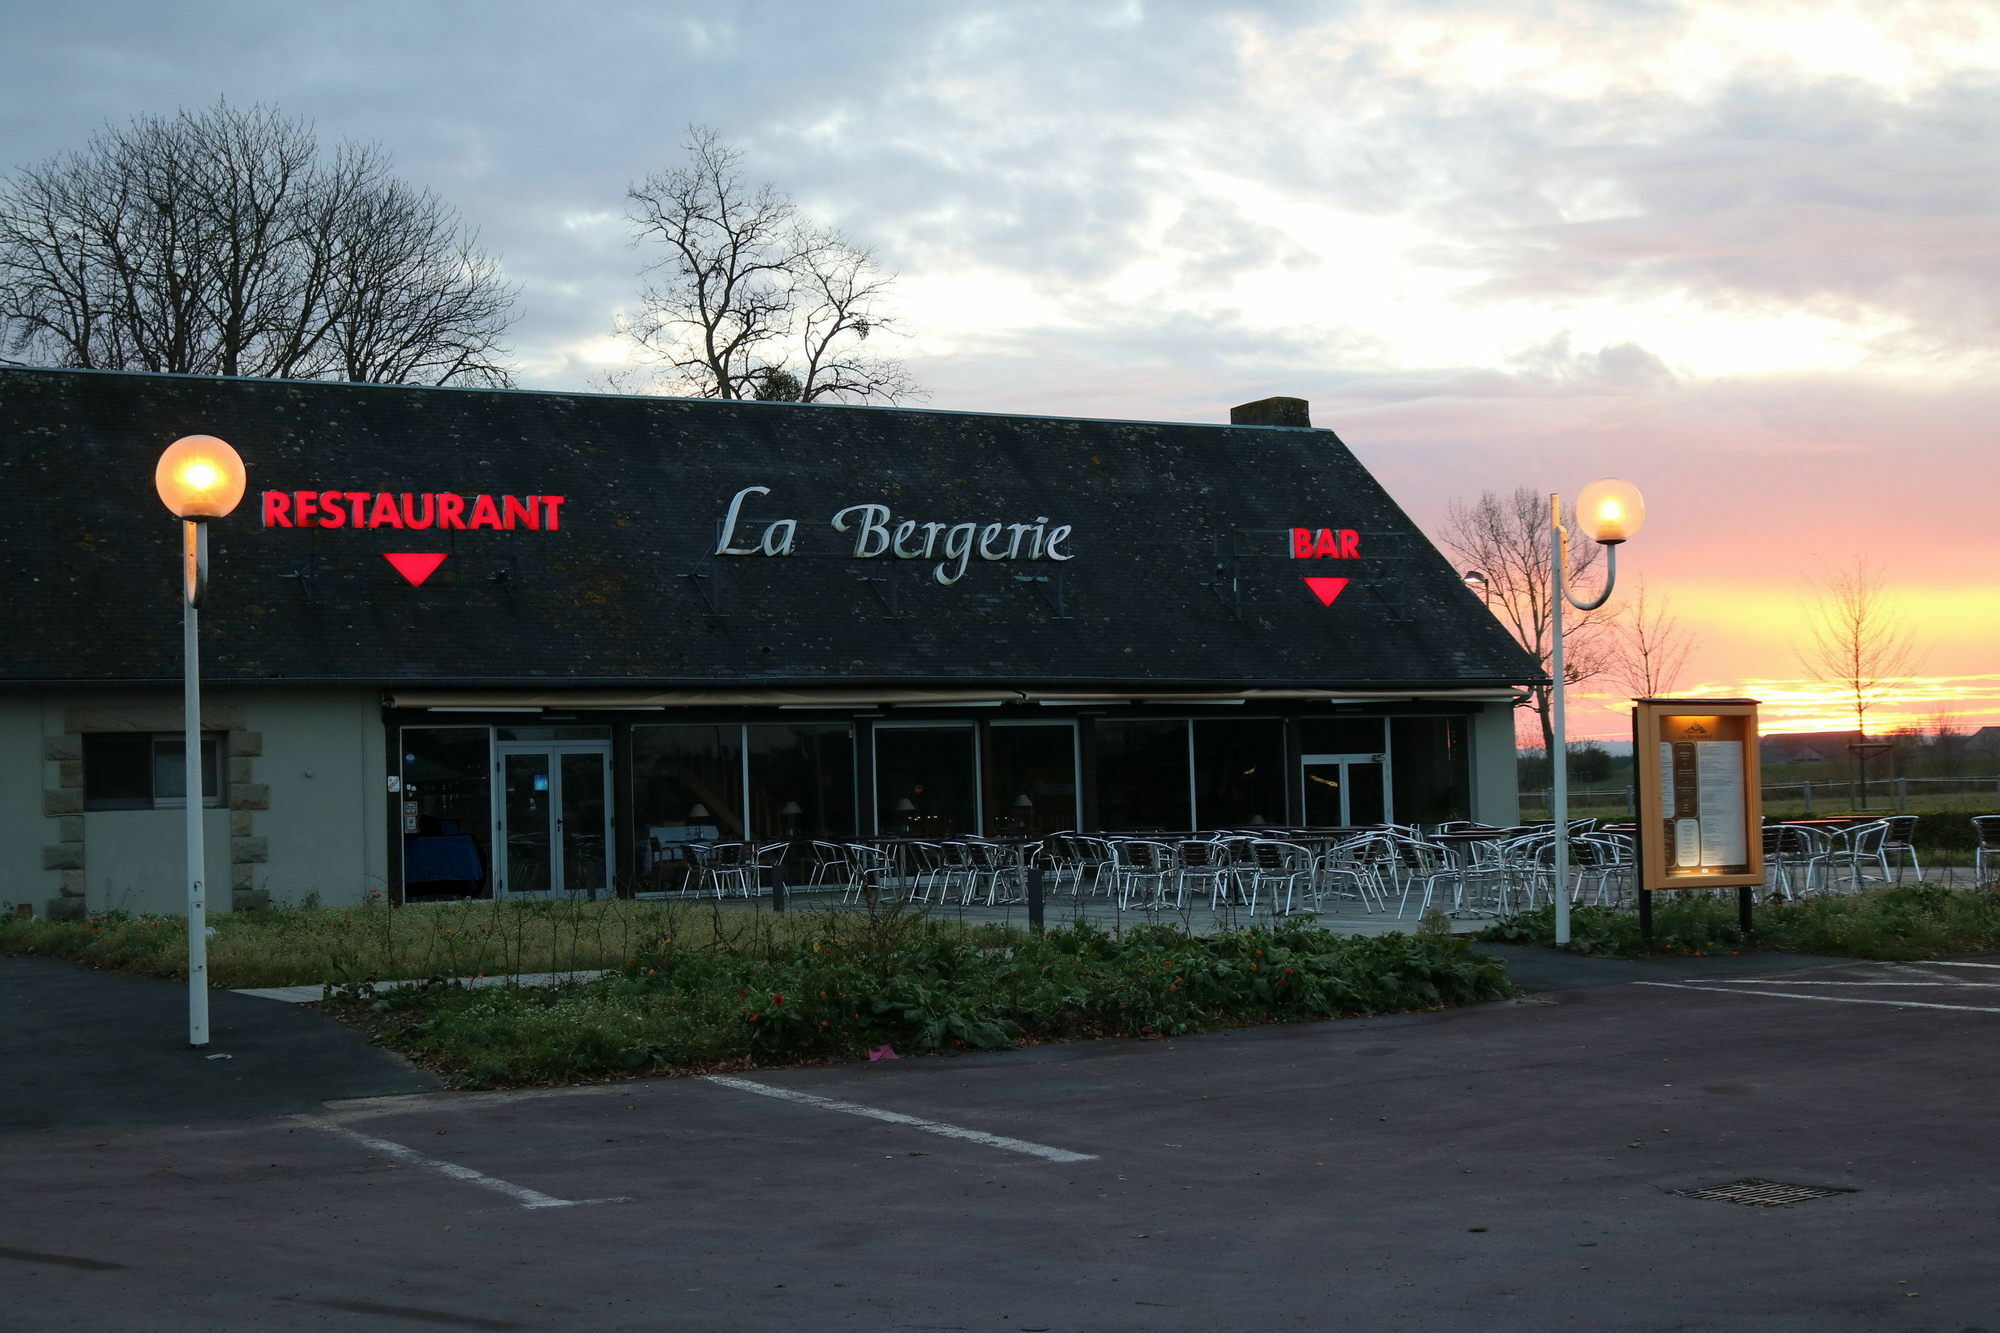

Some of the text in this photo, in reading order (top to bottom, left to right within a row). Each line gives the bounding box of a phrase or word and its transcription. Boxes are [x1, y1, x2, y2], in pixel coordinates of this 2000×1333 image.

[261, 490, 564, 531] RESTAURANT
[716, 486, 1074, 585] La Bergerie
[1290, 528, 1361, 560] BAR
